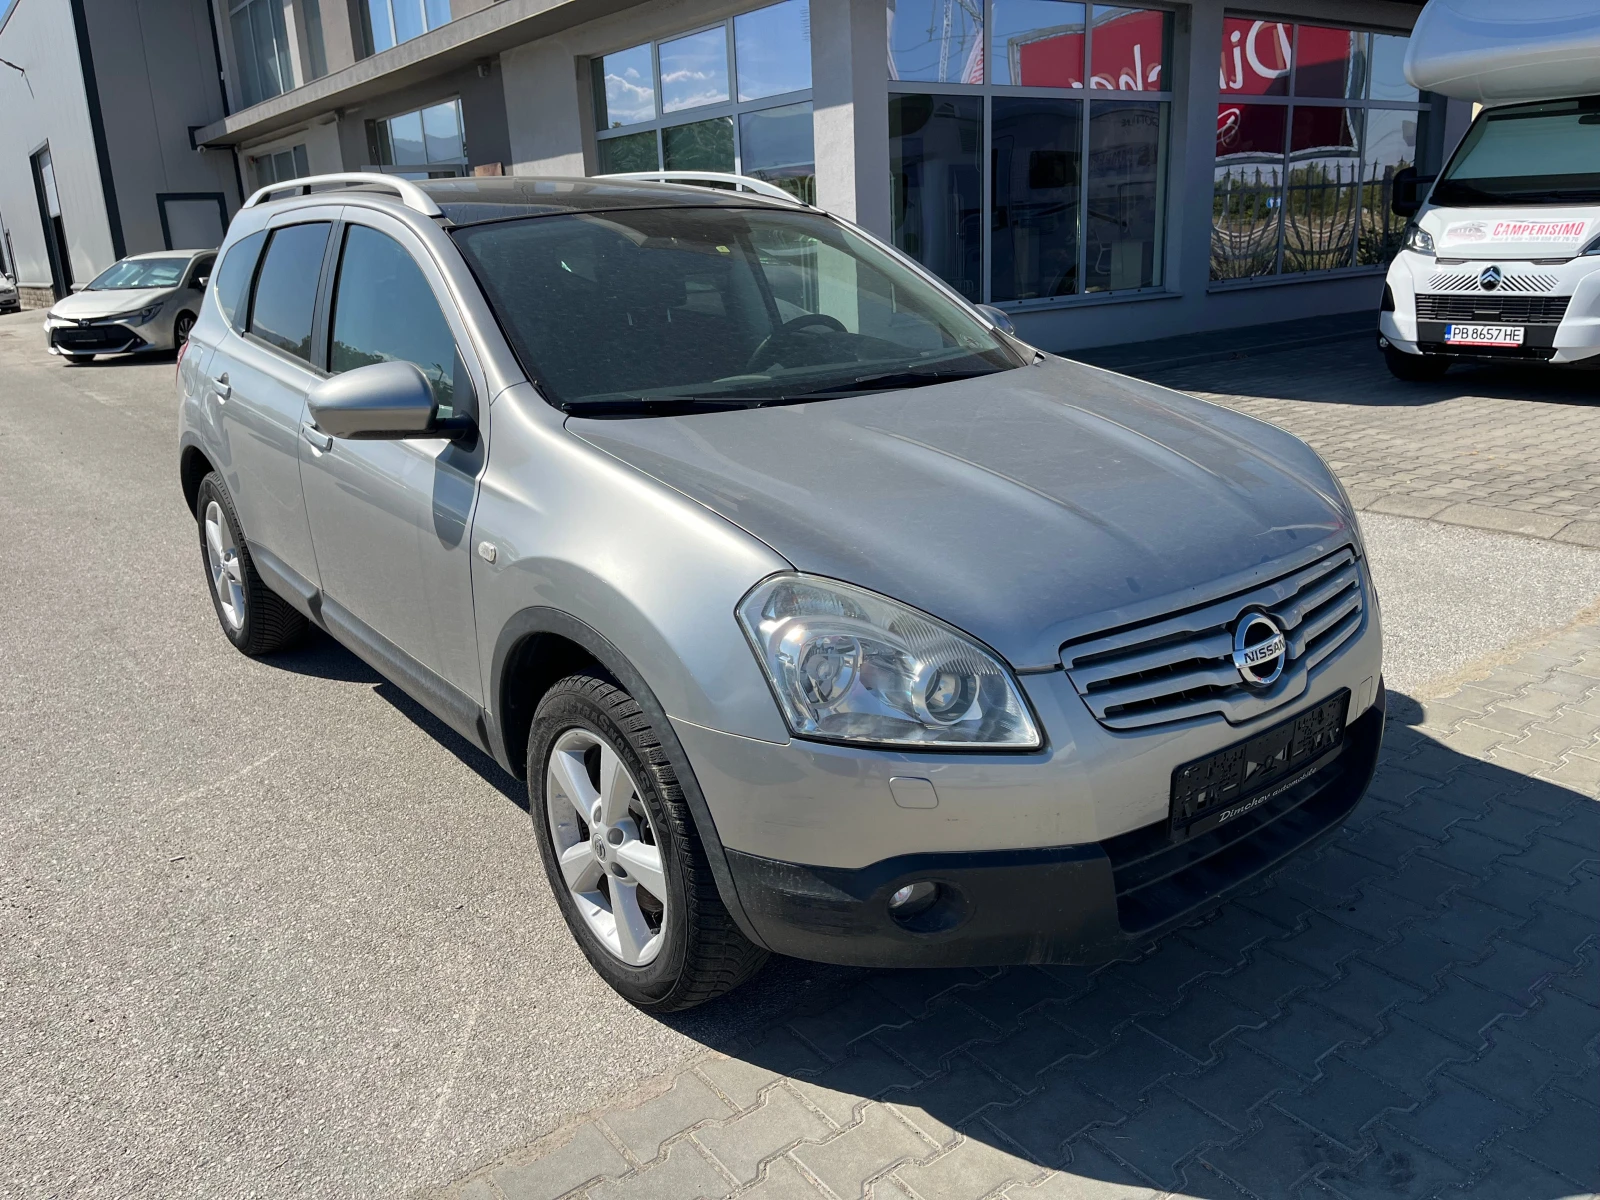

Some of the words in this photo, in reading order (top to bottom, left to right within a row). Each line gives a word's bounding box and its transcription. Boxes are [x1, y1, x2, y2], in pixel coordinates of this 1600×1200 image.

[1493, 222, 1585, 236] CAMPERISIMO
[1452, 327, 1469, 340] PB
[1471, 328, 1502, 341] 8657
[1503, 329, 1521, 342] HE
[1243, 638, 1285, 664] NISSAN
[638, 769, 670, 833] SUV
[1218, 793, 1271, 823] Dimchev
